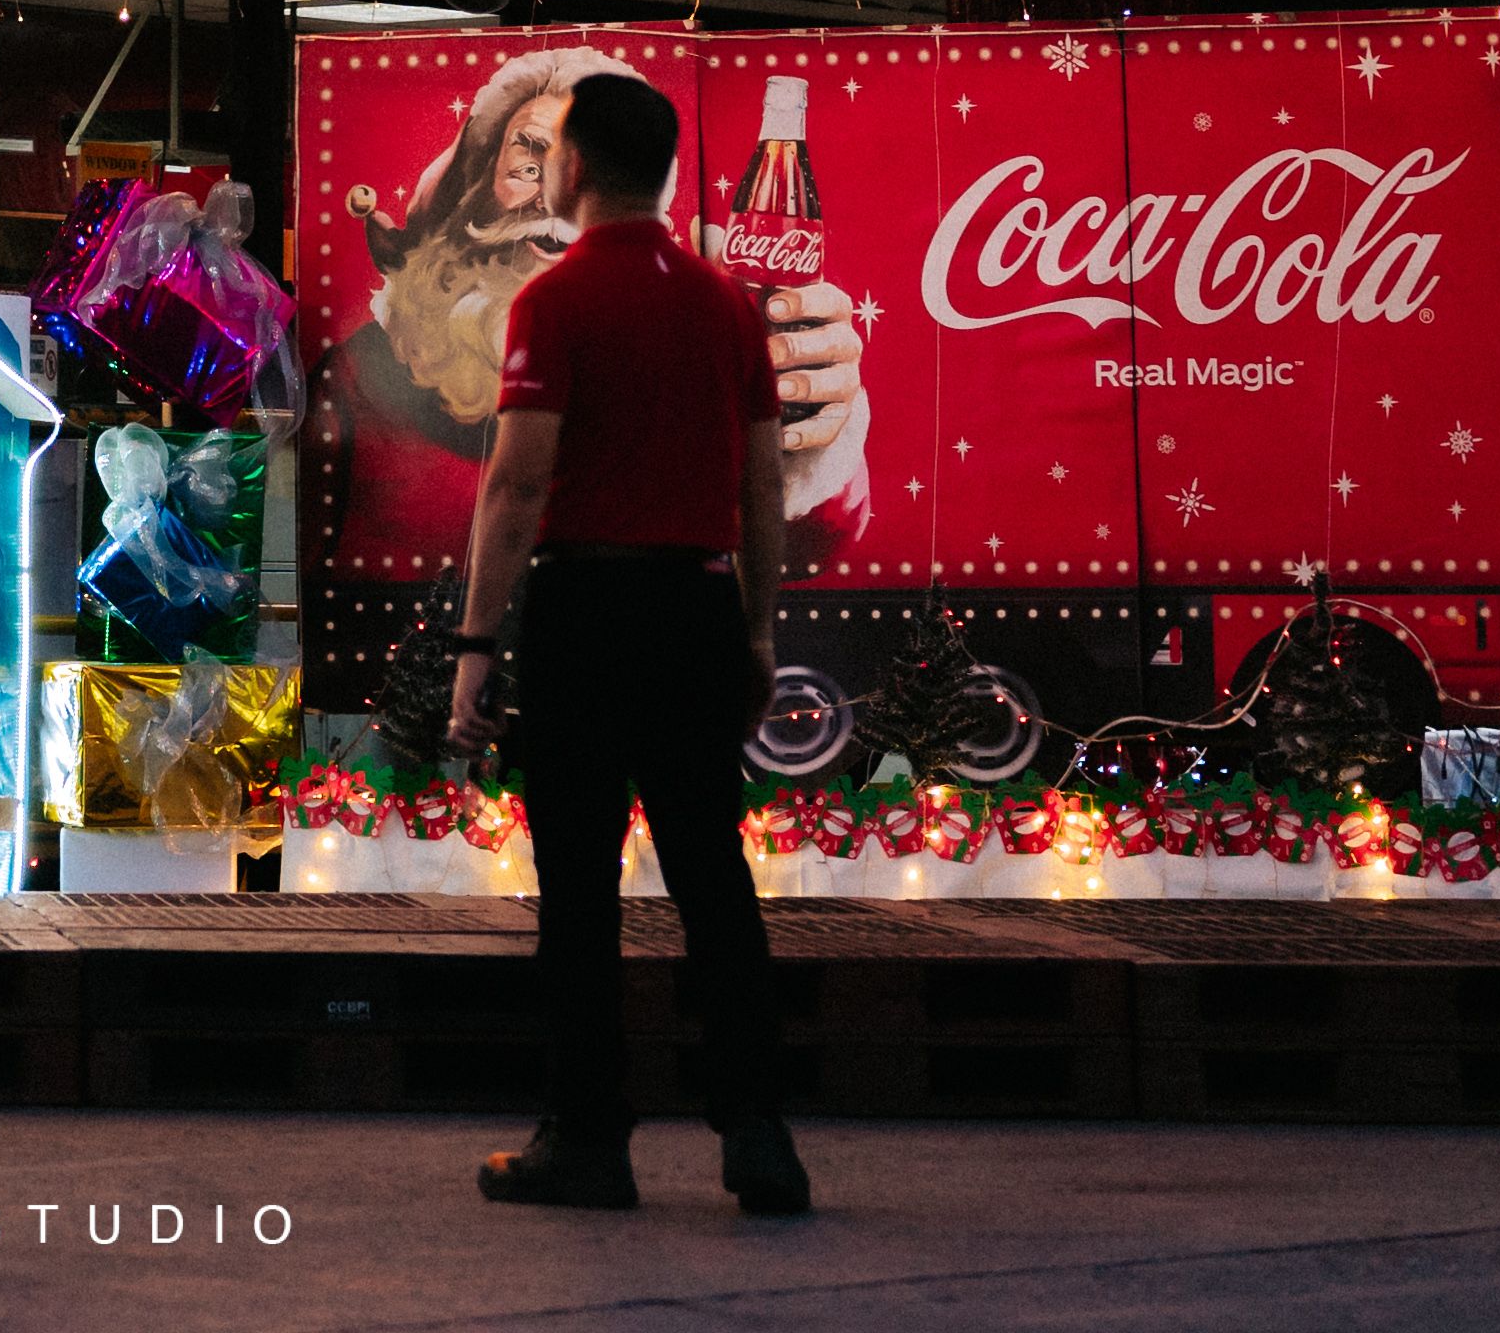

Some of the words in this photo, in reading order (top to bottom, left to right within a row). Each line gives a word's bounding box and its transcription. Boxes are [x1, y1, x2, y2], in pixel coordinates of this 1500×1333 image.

[85, 155, 138, 172] WINDOW
[721, 224, 823, 274] Coca-Cola
[921, 145, 1472, 331] Coca-Cola
[1095, 357, 1173, 387] Real
[1187, 356, 1296, 392] Magic
